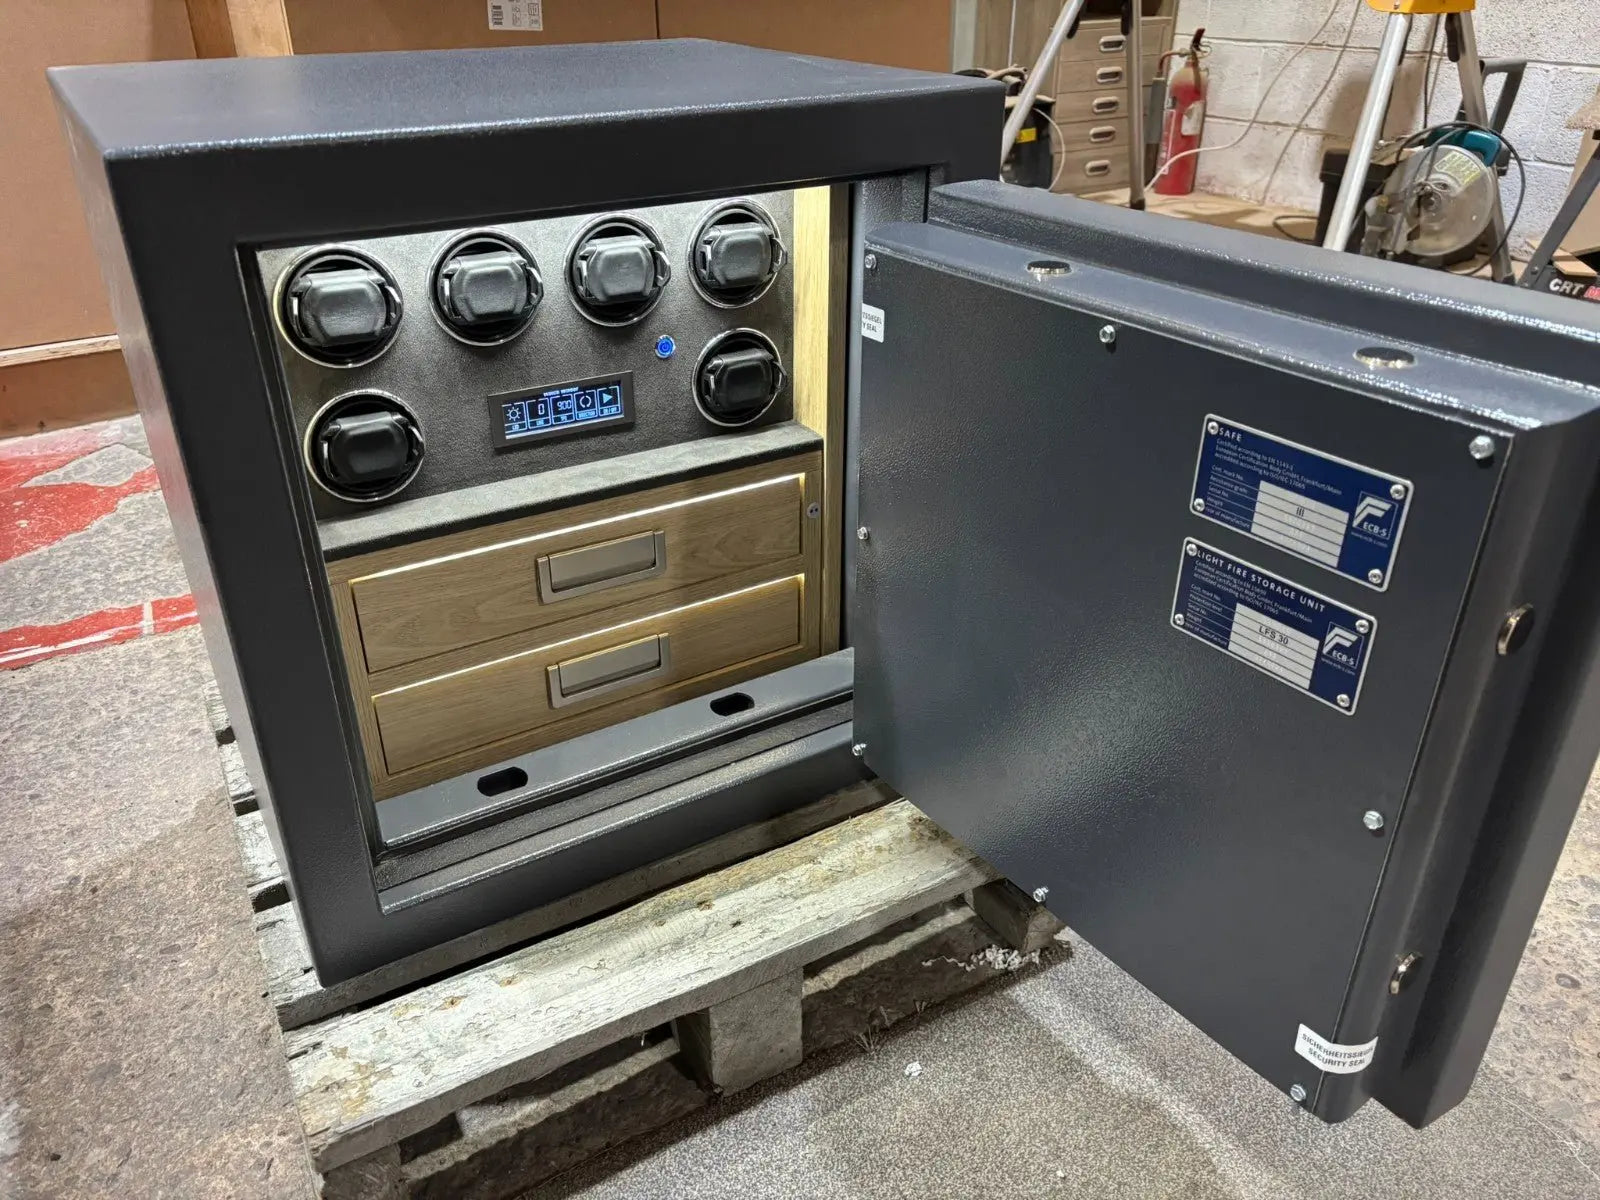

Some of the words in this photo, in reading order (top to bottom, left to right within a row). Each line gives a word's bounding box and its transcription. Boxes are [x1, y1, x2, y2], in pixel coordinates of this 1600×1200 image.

[1549, 278, 1585, 295] CRT
[537, 403, 545, 416] 0
[556, 399, 573, 412] 900
[1219, 427, 1242, 442] SAFE
[1197, 550, 1224, 568] LIGHT
[1227, 563, 1247, 578] FIRE
[1251, 574, 1296, 600] STORAGE
[1299, 595, 1325, 613] UNIT
[1259, 625, 1277, 640] LFS
[1278, 634, 1289, 645] 30
[1308, 1046, 1348, 1068] SECURITY
